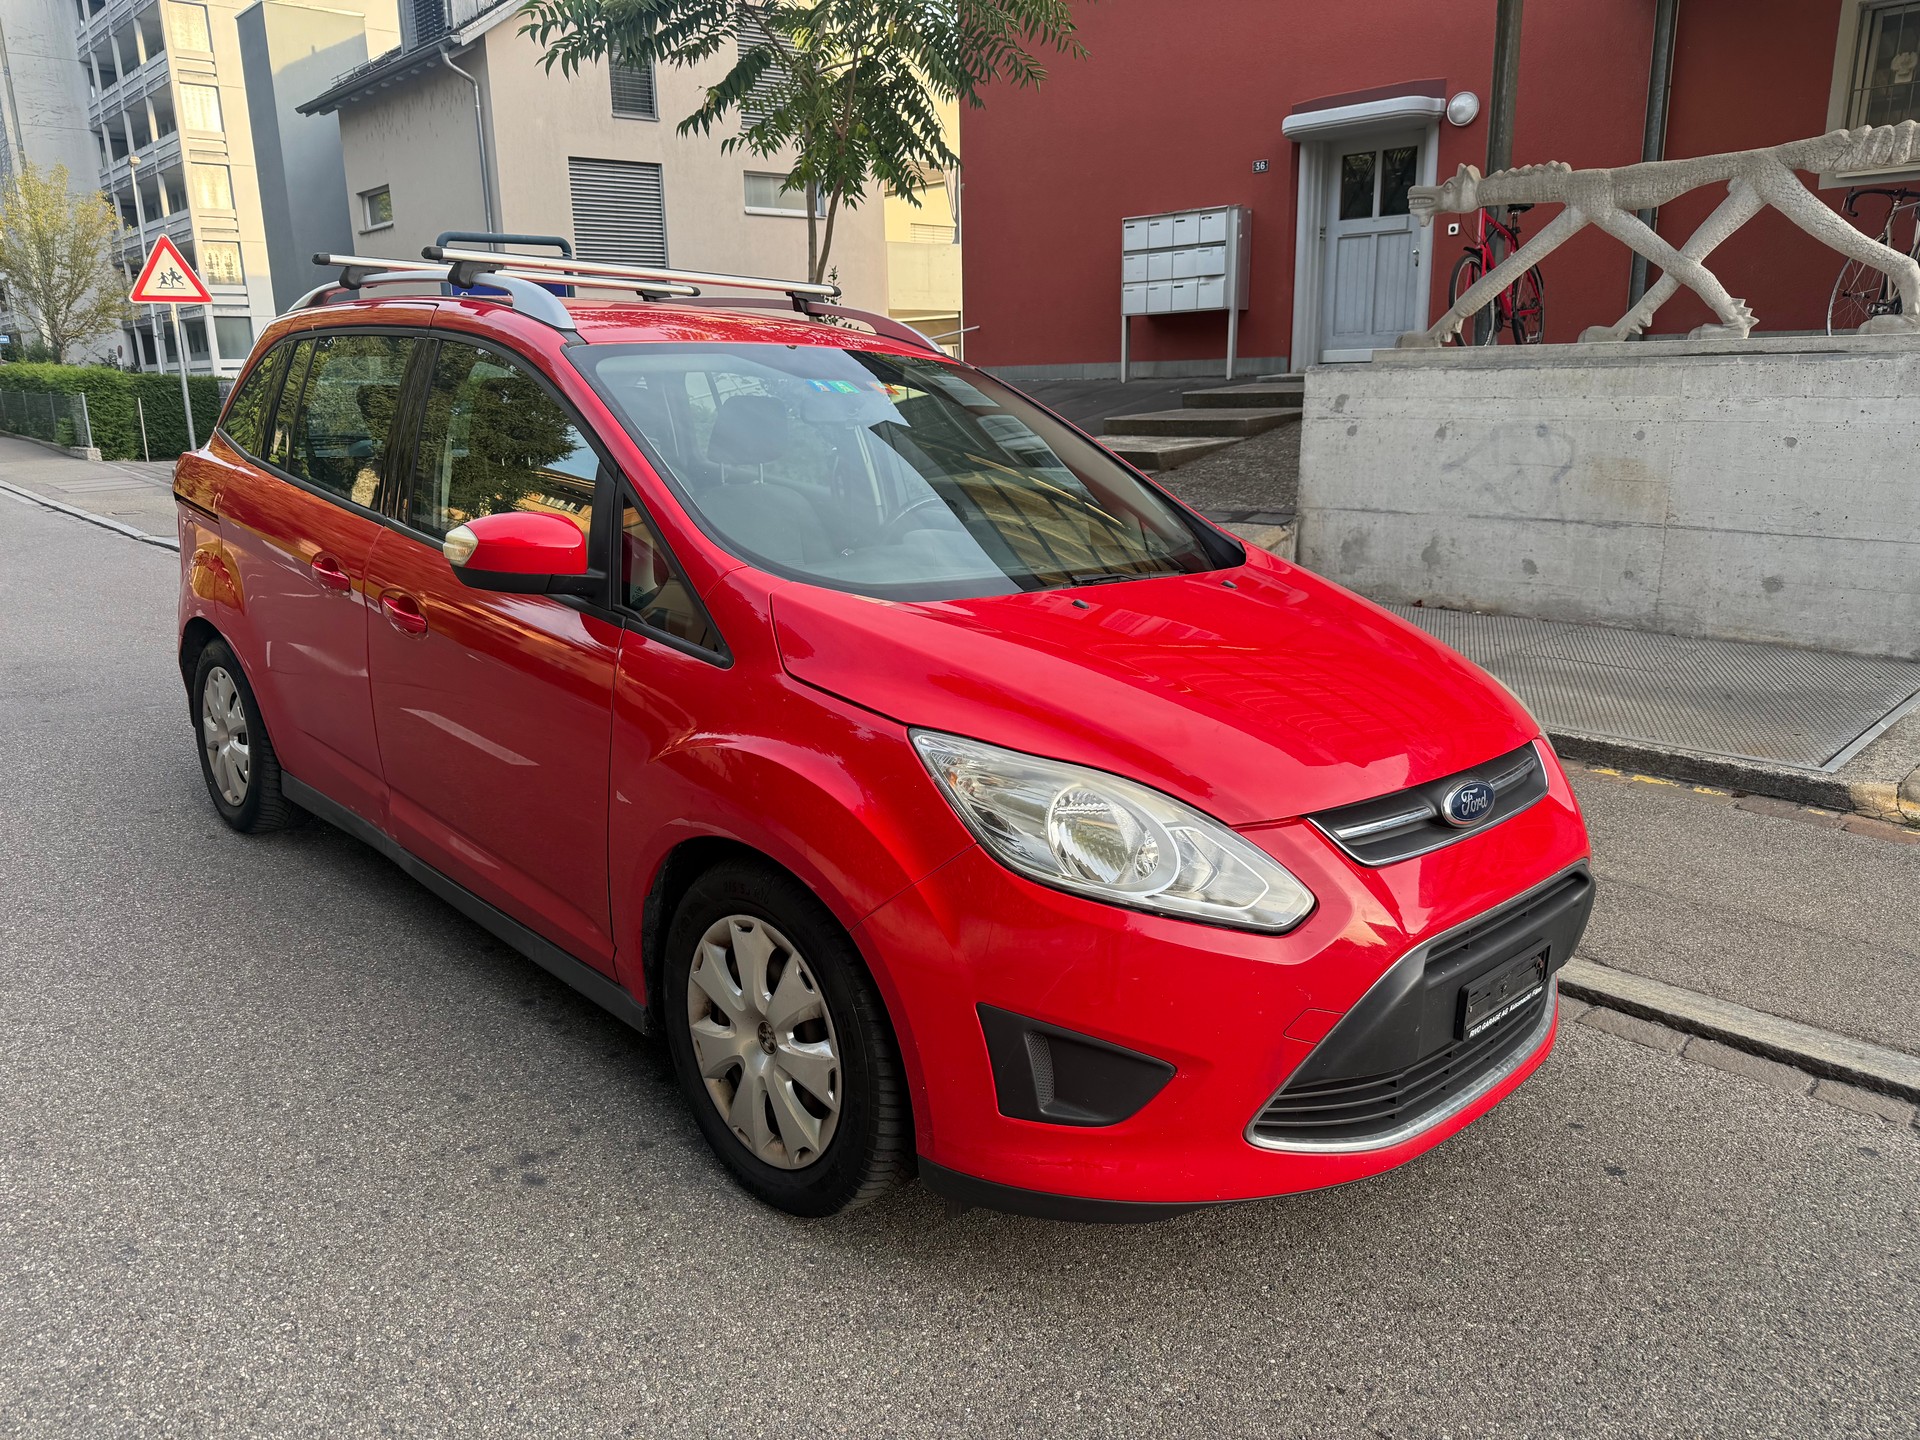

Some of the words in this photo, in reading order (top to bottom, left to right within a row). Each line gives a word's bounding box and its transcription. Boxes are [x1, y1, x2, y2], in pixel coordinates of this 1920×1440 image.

[1255, 161, 1266, 171] 36
[1460, 787, 1488, 816] Ford
[1482, 1012, 1501, 1030] GARAGE
[1501, 1007, 1509, 1017] AG
